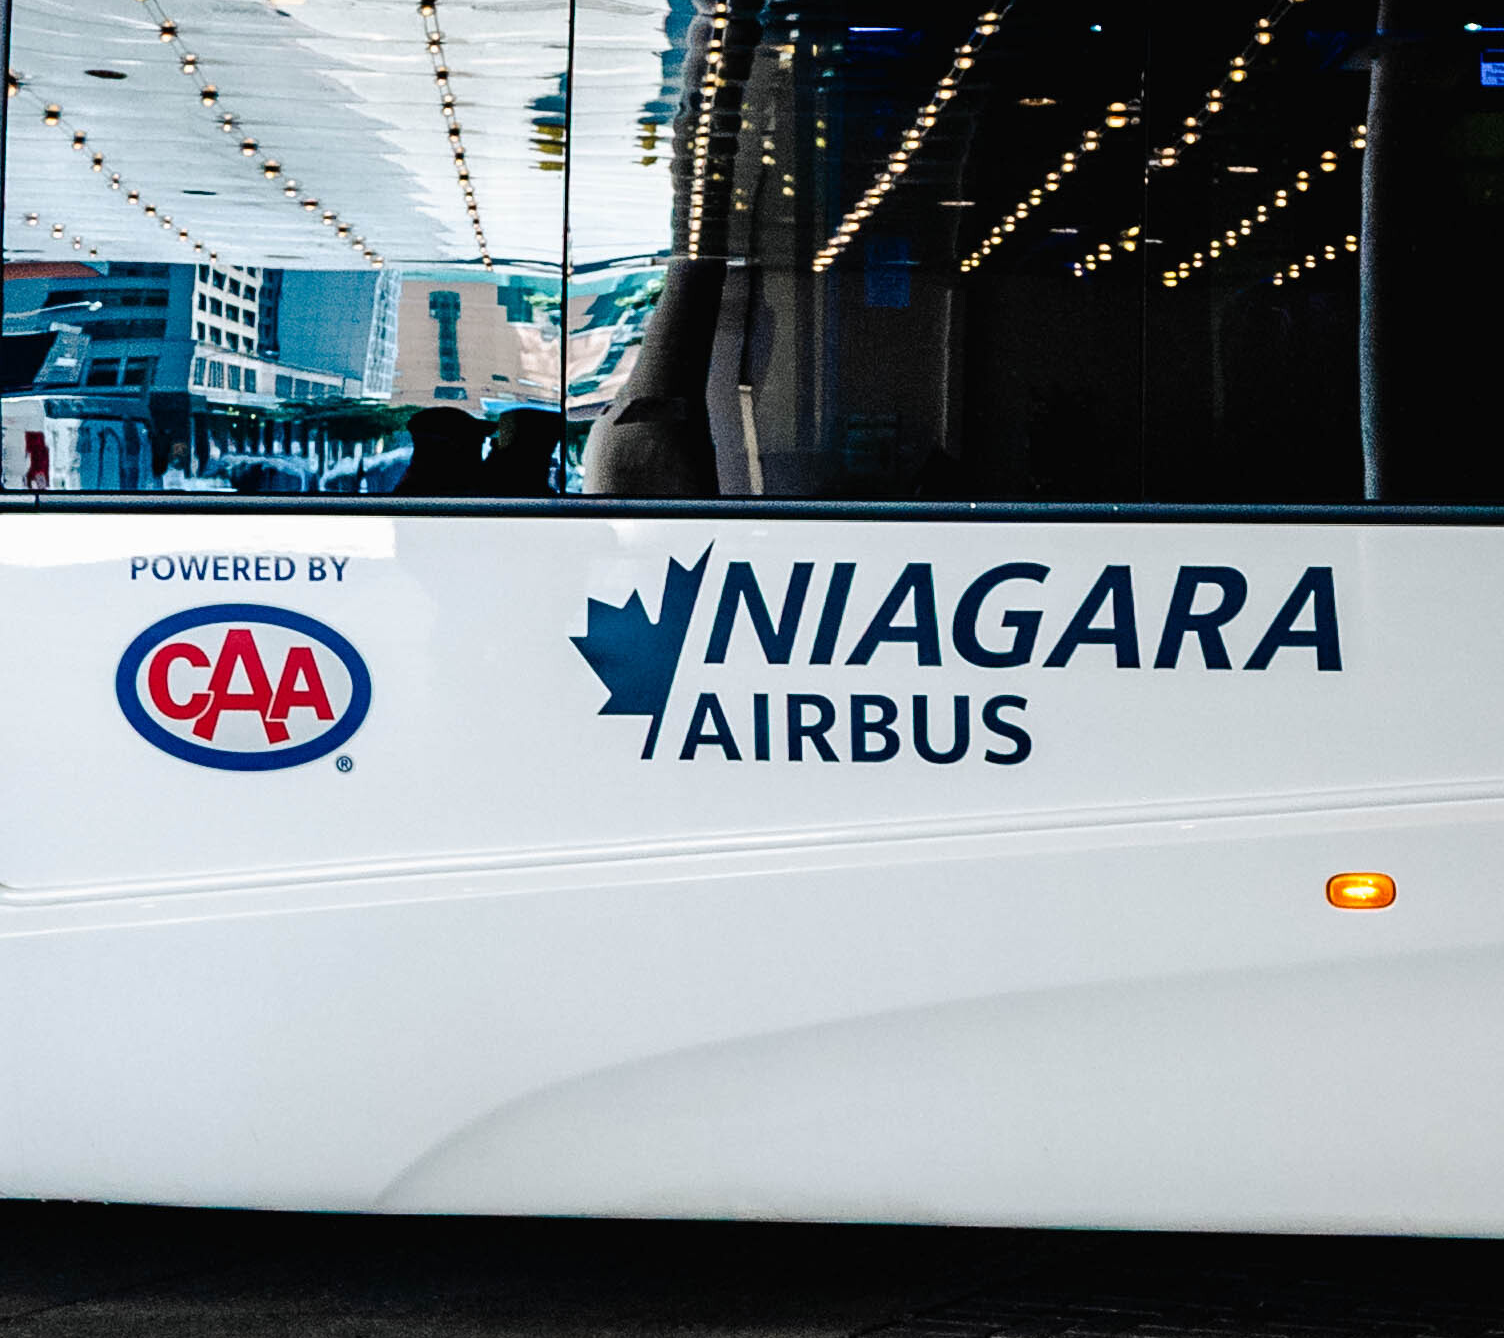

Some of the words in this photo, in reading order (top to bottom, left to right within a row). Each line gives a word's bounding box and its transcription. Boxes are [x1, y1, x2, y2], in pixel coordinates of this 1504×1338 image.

[130, 555, 296, 581] POWERED
[308, 556, 350, 582] BY
[703, 560, 1343, 673] NIAGARA
[148, 629, 335, 745] CAA
[680, 692, 1033, 766] AIRBUS
